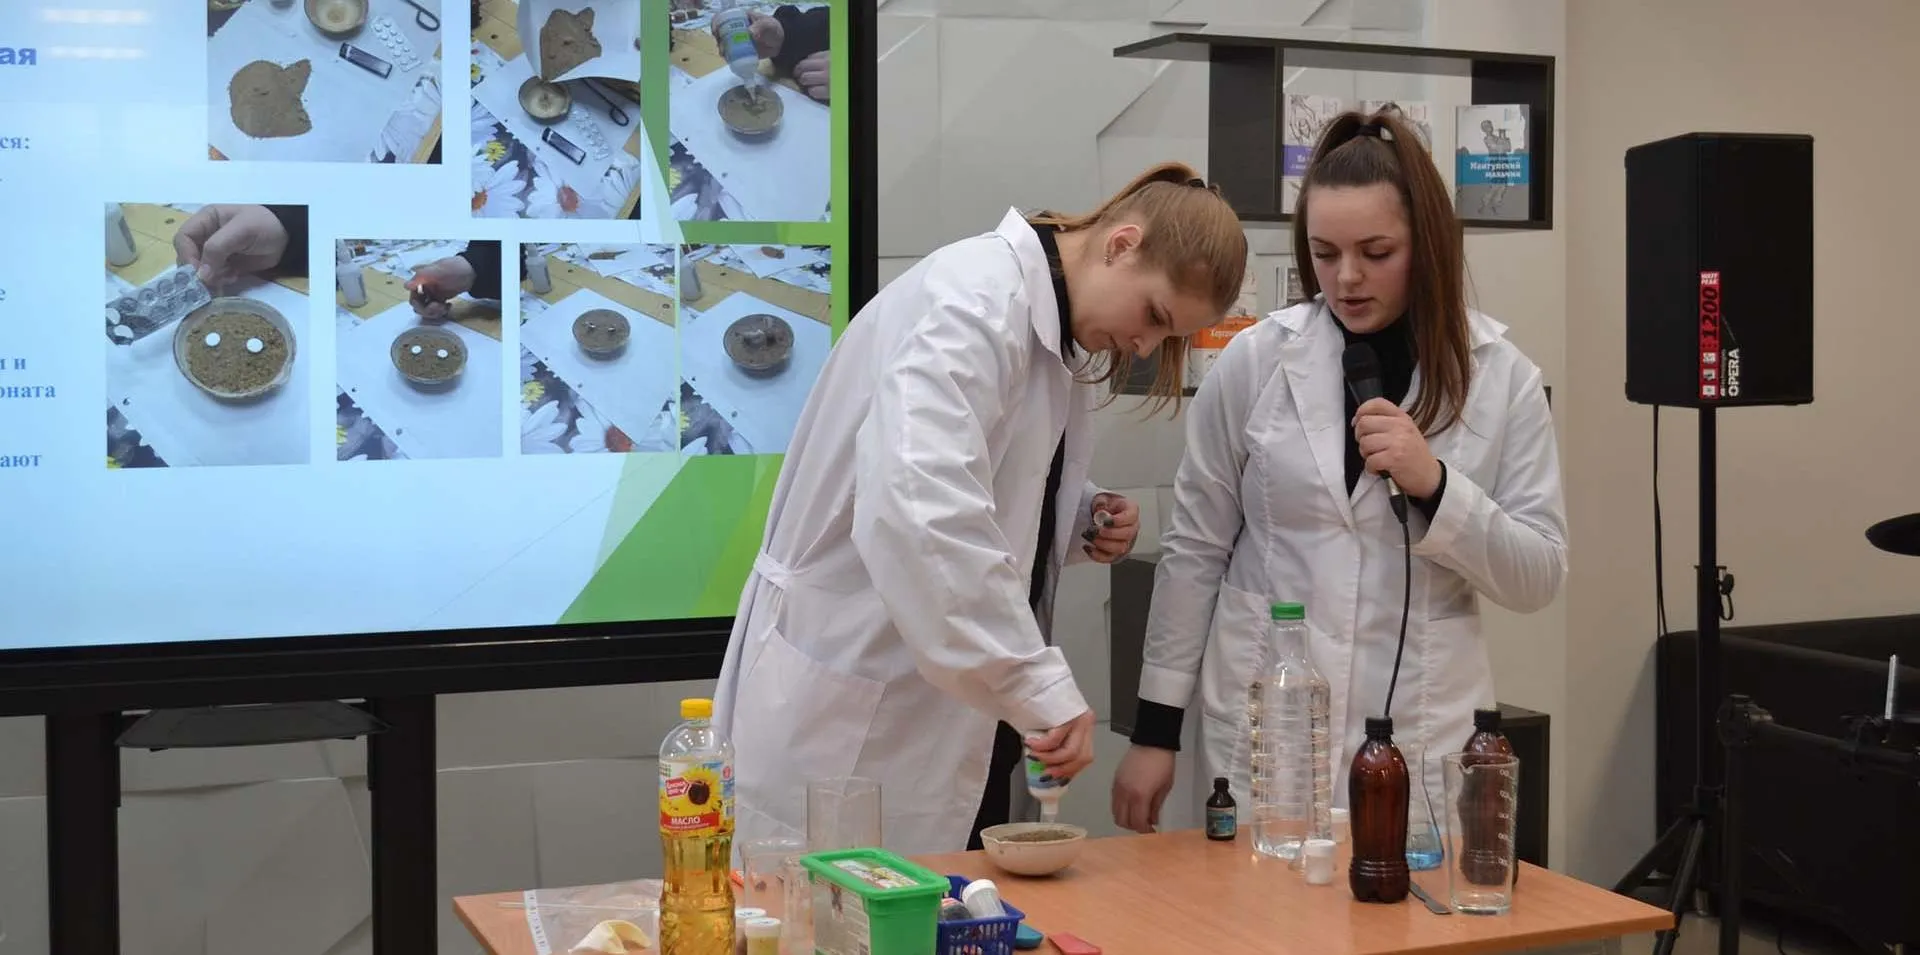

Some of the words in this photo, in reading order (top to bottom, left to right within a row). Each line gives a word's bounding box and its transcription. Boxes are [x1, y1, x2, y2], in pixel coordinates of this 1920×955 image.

[1702, 286, 1718, 338] 1200
[13, 358, 27, 370] и
[1728, 348, 1740, 397] OPERA
[671, 816, 701, 825] МАСЛО
